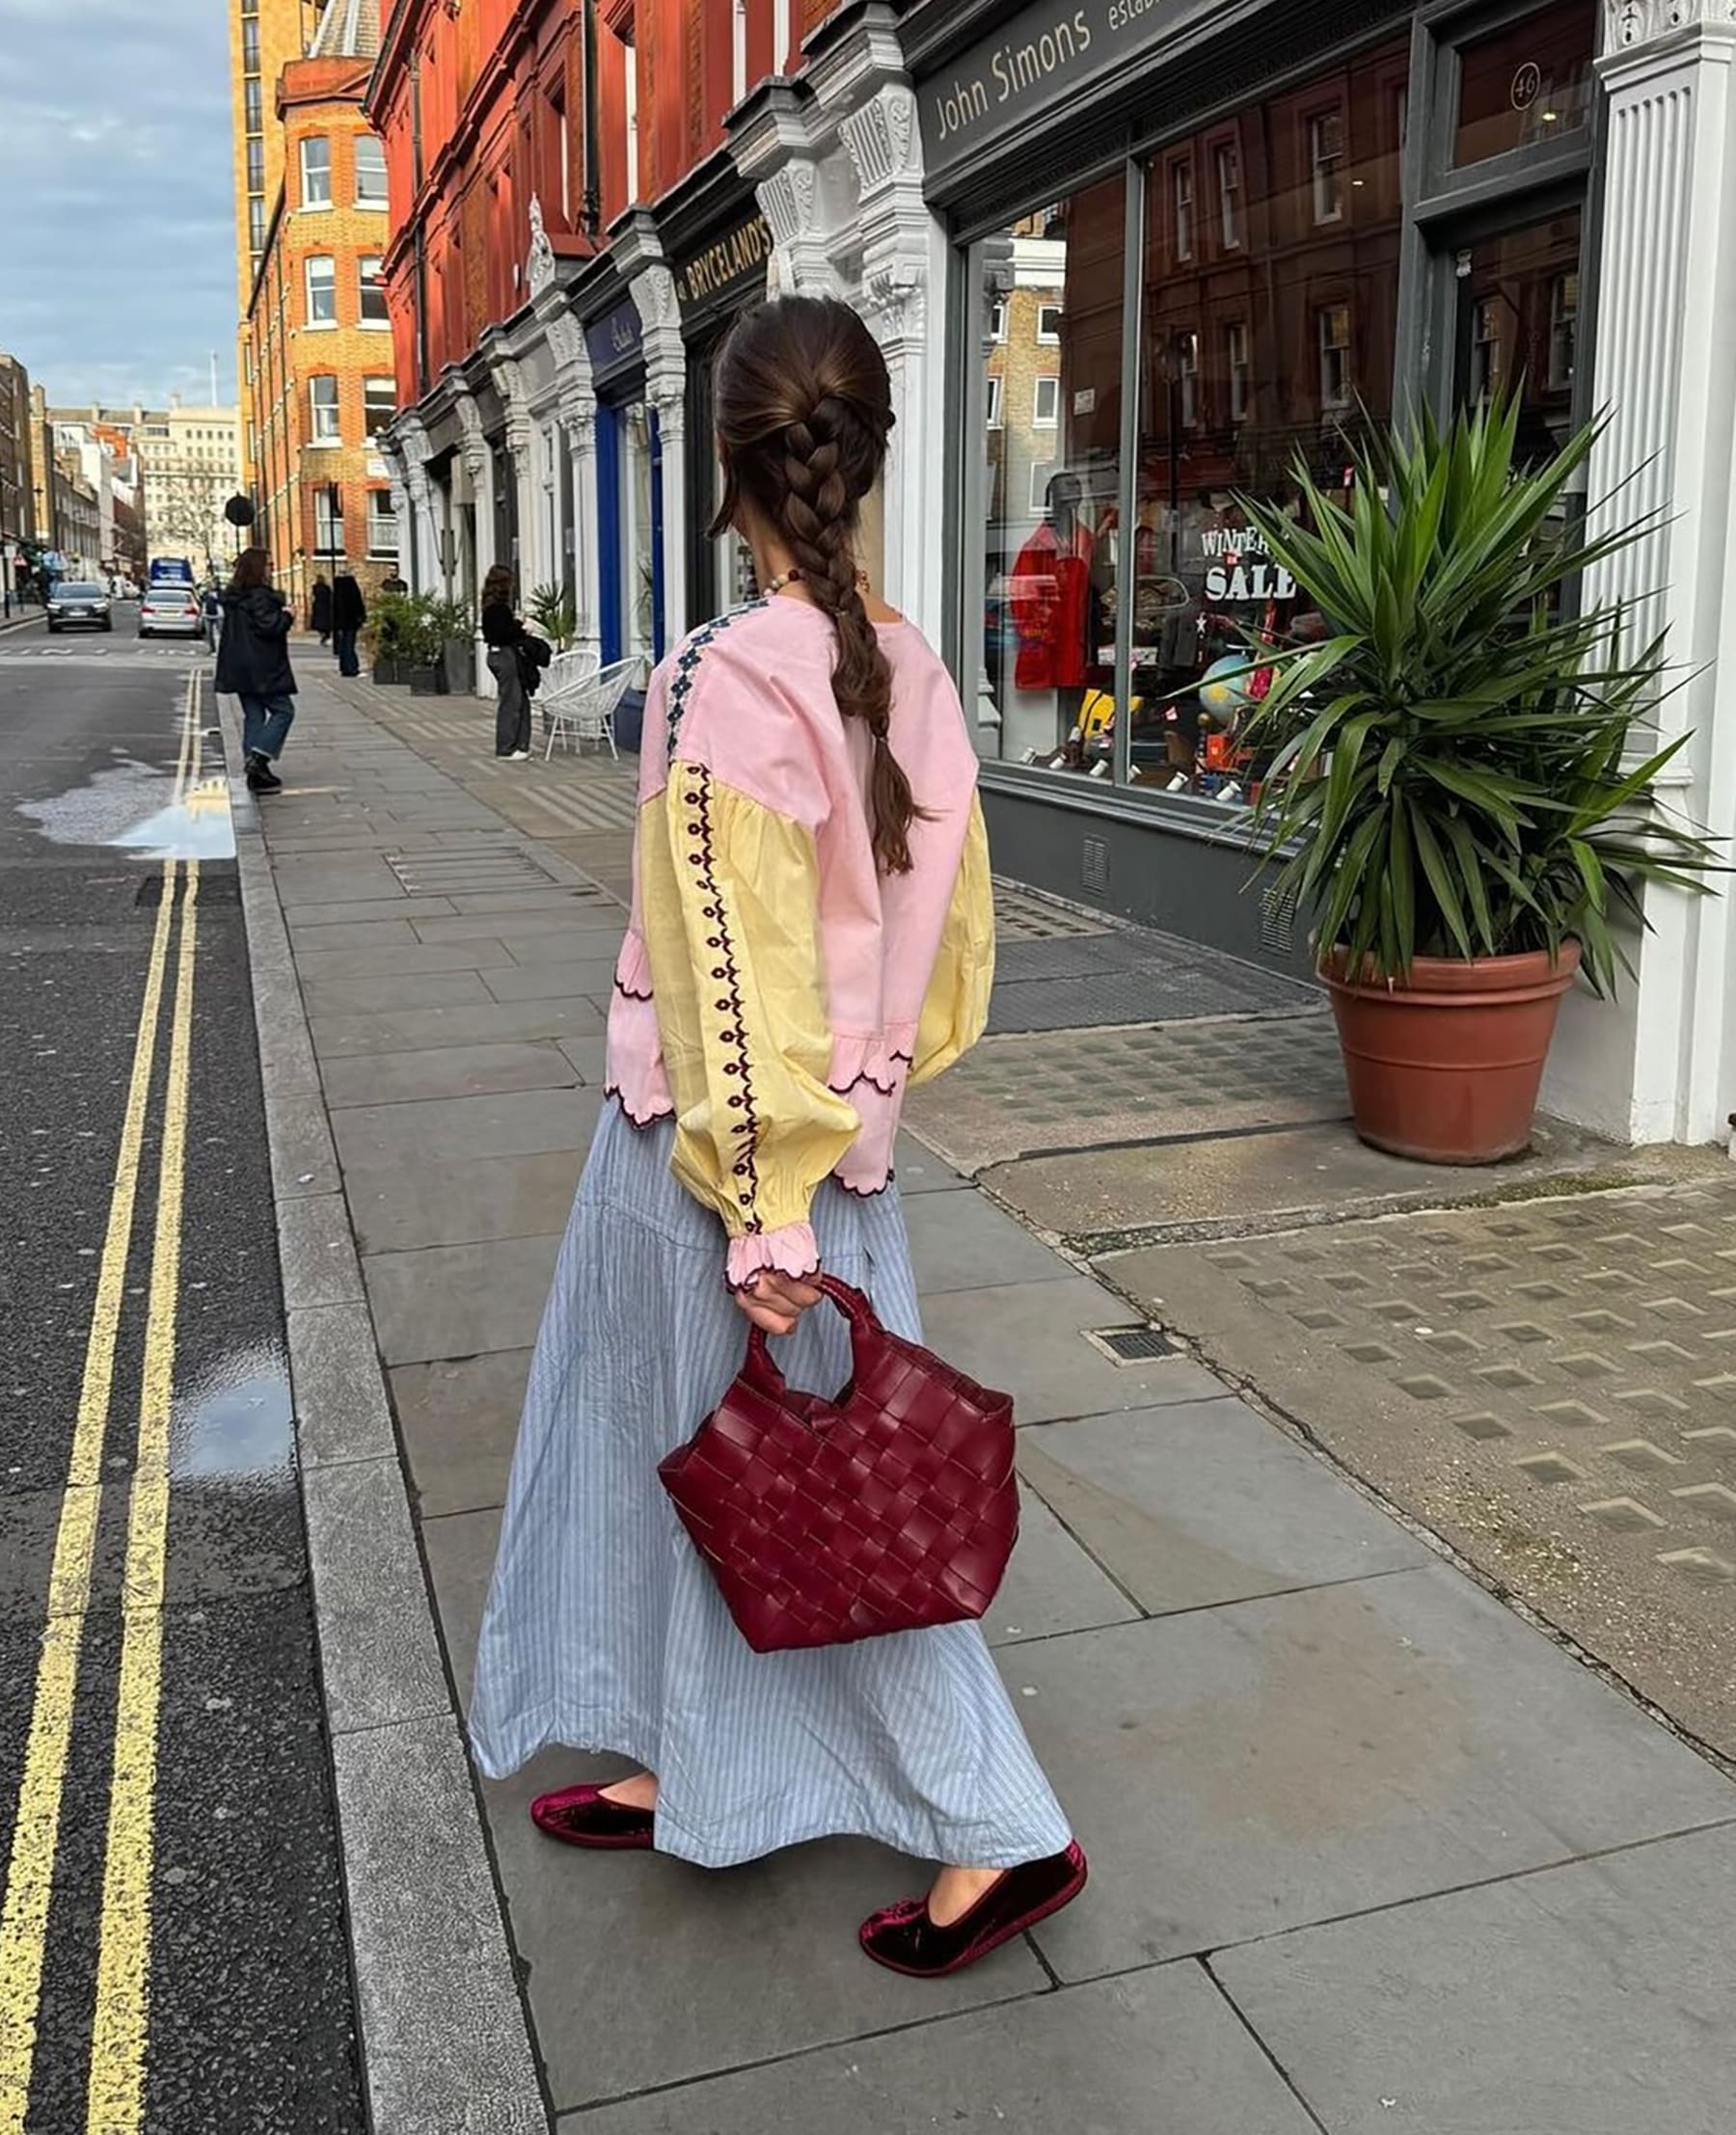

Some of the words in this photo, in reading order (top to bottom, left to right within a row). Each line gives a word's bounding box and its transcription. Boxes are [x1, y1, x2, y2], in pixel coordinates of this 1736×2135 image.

[936, 80, 989, 141] John
[991, 10, 1092, 102] Simons
[1108, 0, 1159, 31] esta
[1514, 70, 1536, 97] 46
[1204, 562, 1297, 601] SALE
